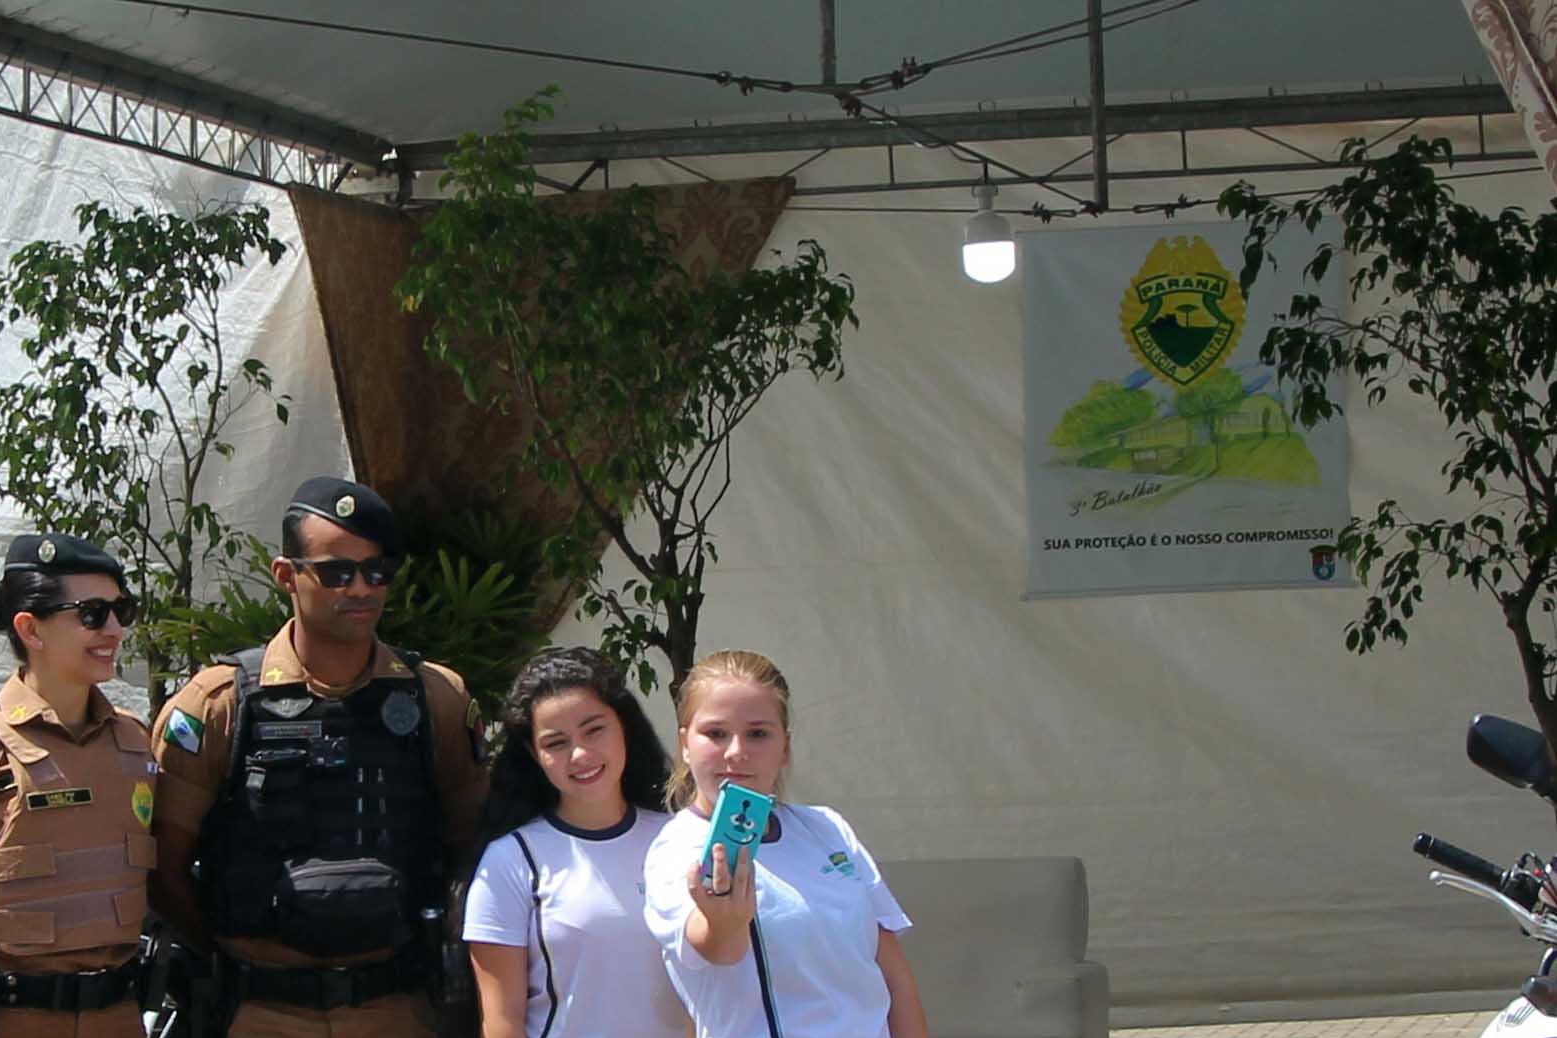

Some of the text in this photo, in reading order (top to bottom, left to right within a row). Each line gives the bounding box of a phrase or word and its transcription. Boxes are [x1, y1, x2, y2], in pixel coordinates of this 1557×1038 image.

[1190, 325, 1230, 373] MILITAR
[1043, 527, 1335, 551] SUA PROTEÇÃO É O NOSSO COMPROMISSO!
